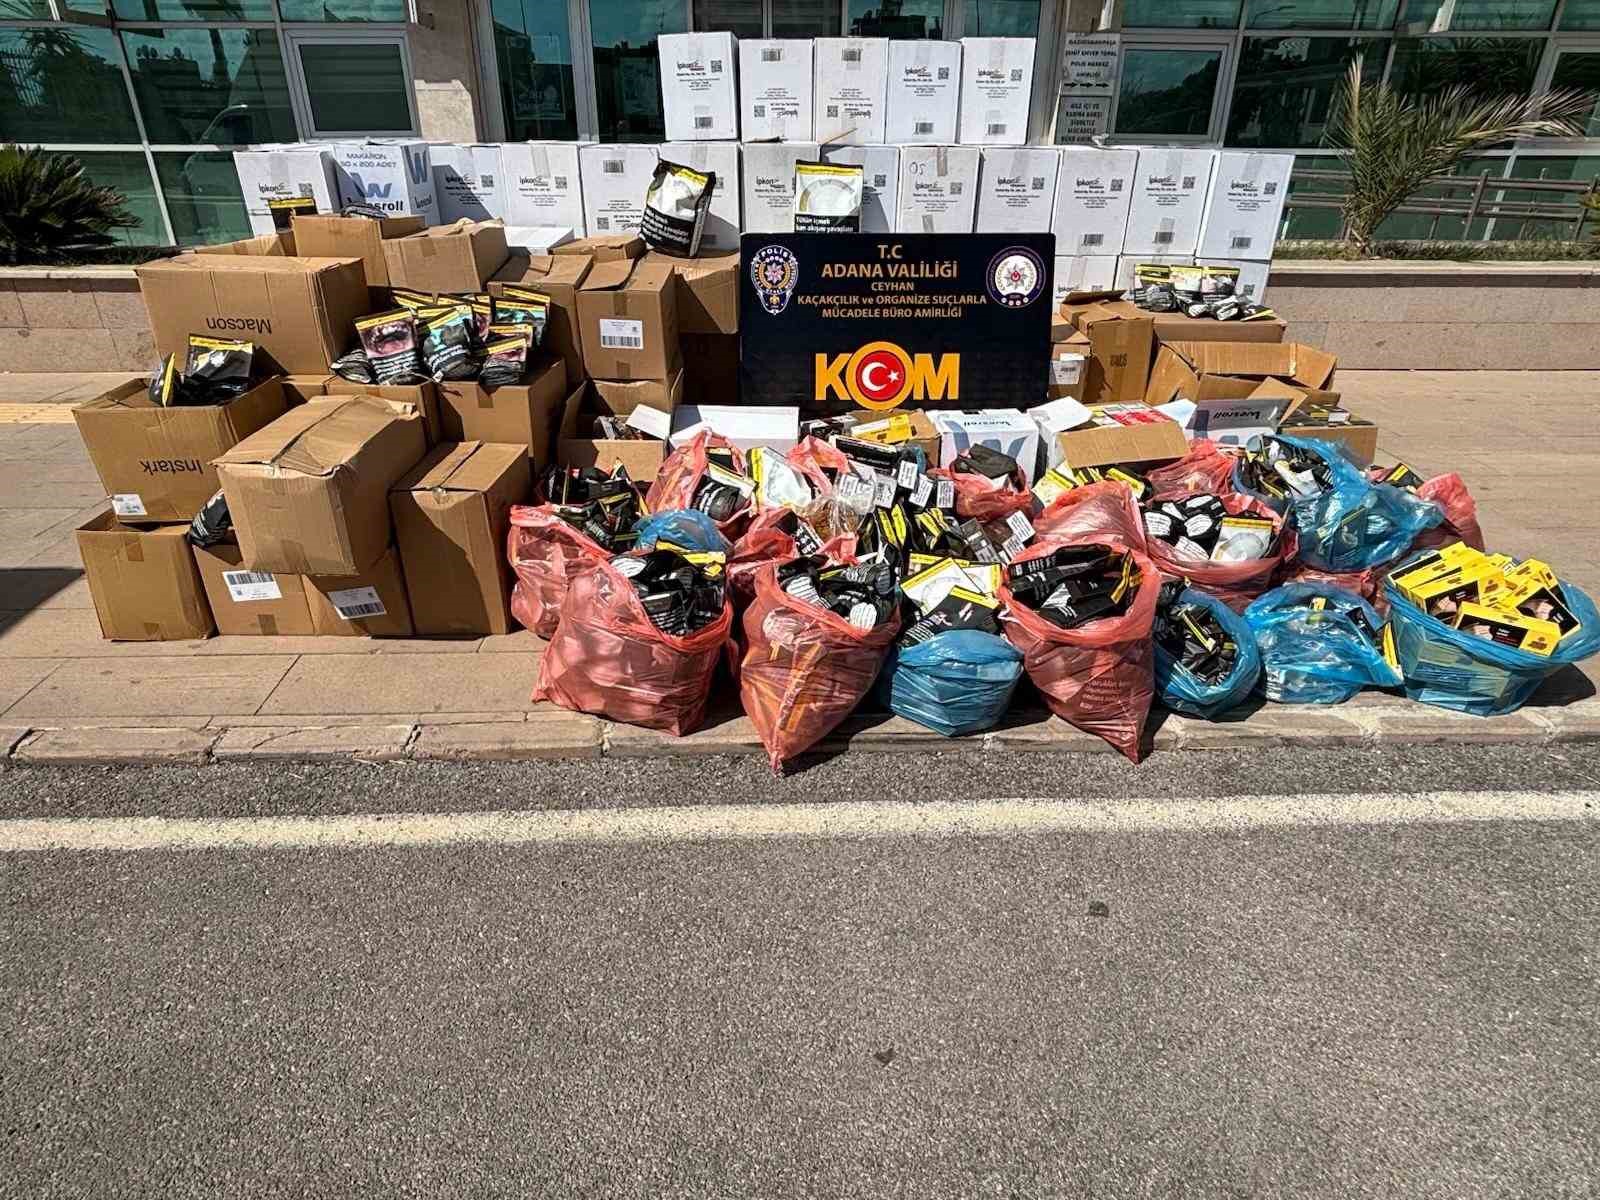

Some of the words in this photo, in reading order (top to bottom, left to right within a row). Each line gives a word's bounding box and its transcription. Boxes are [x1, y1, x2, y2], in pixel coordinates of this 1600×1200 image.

[761, 247, 789, 257] POLİS
[877, 245, 903, 259] T.C
[821, 263, 883, 278] ADANA
[887, 261, 958, 278] VALİLİĞİ
[871, 281, 914, 292] CEYHAN
[797, 295, 860, 307] KAÇAKÇILIK
[862, 297, 875, 305] ve
[876, 293, 930, 305] ORGANİZE
[933, 295, 987, 307] SUÇLARLA
[822, 307, 881, 318] MÜCADELE
[882, 307, 913, 318] BÜRO
[914, 306, 962, 318] AMİRLİĞİ
[206, 317, 272, 334] Macson
[815, 341, 960, 411] KOM
[140, 459, 204, 475] Instark
